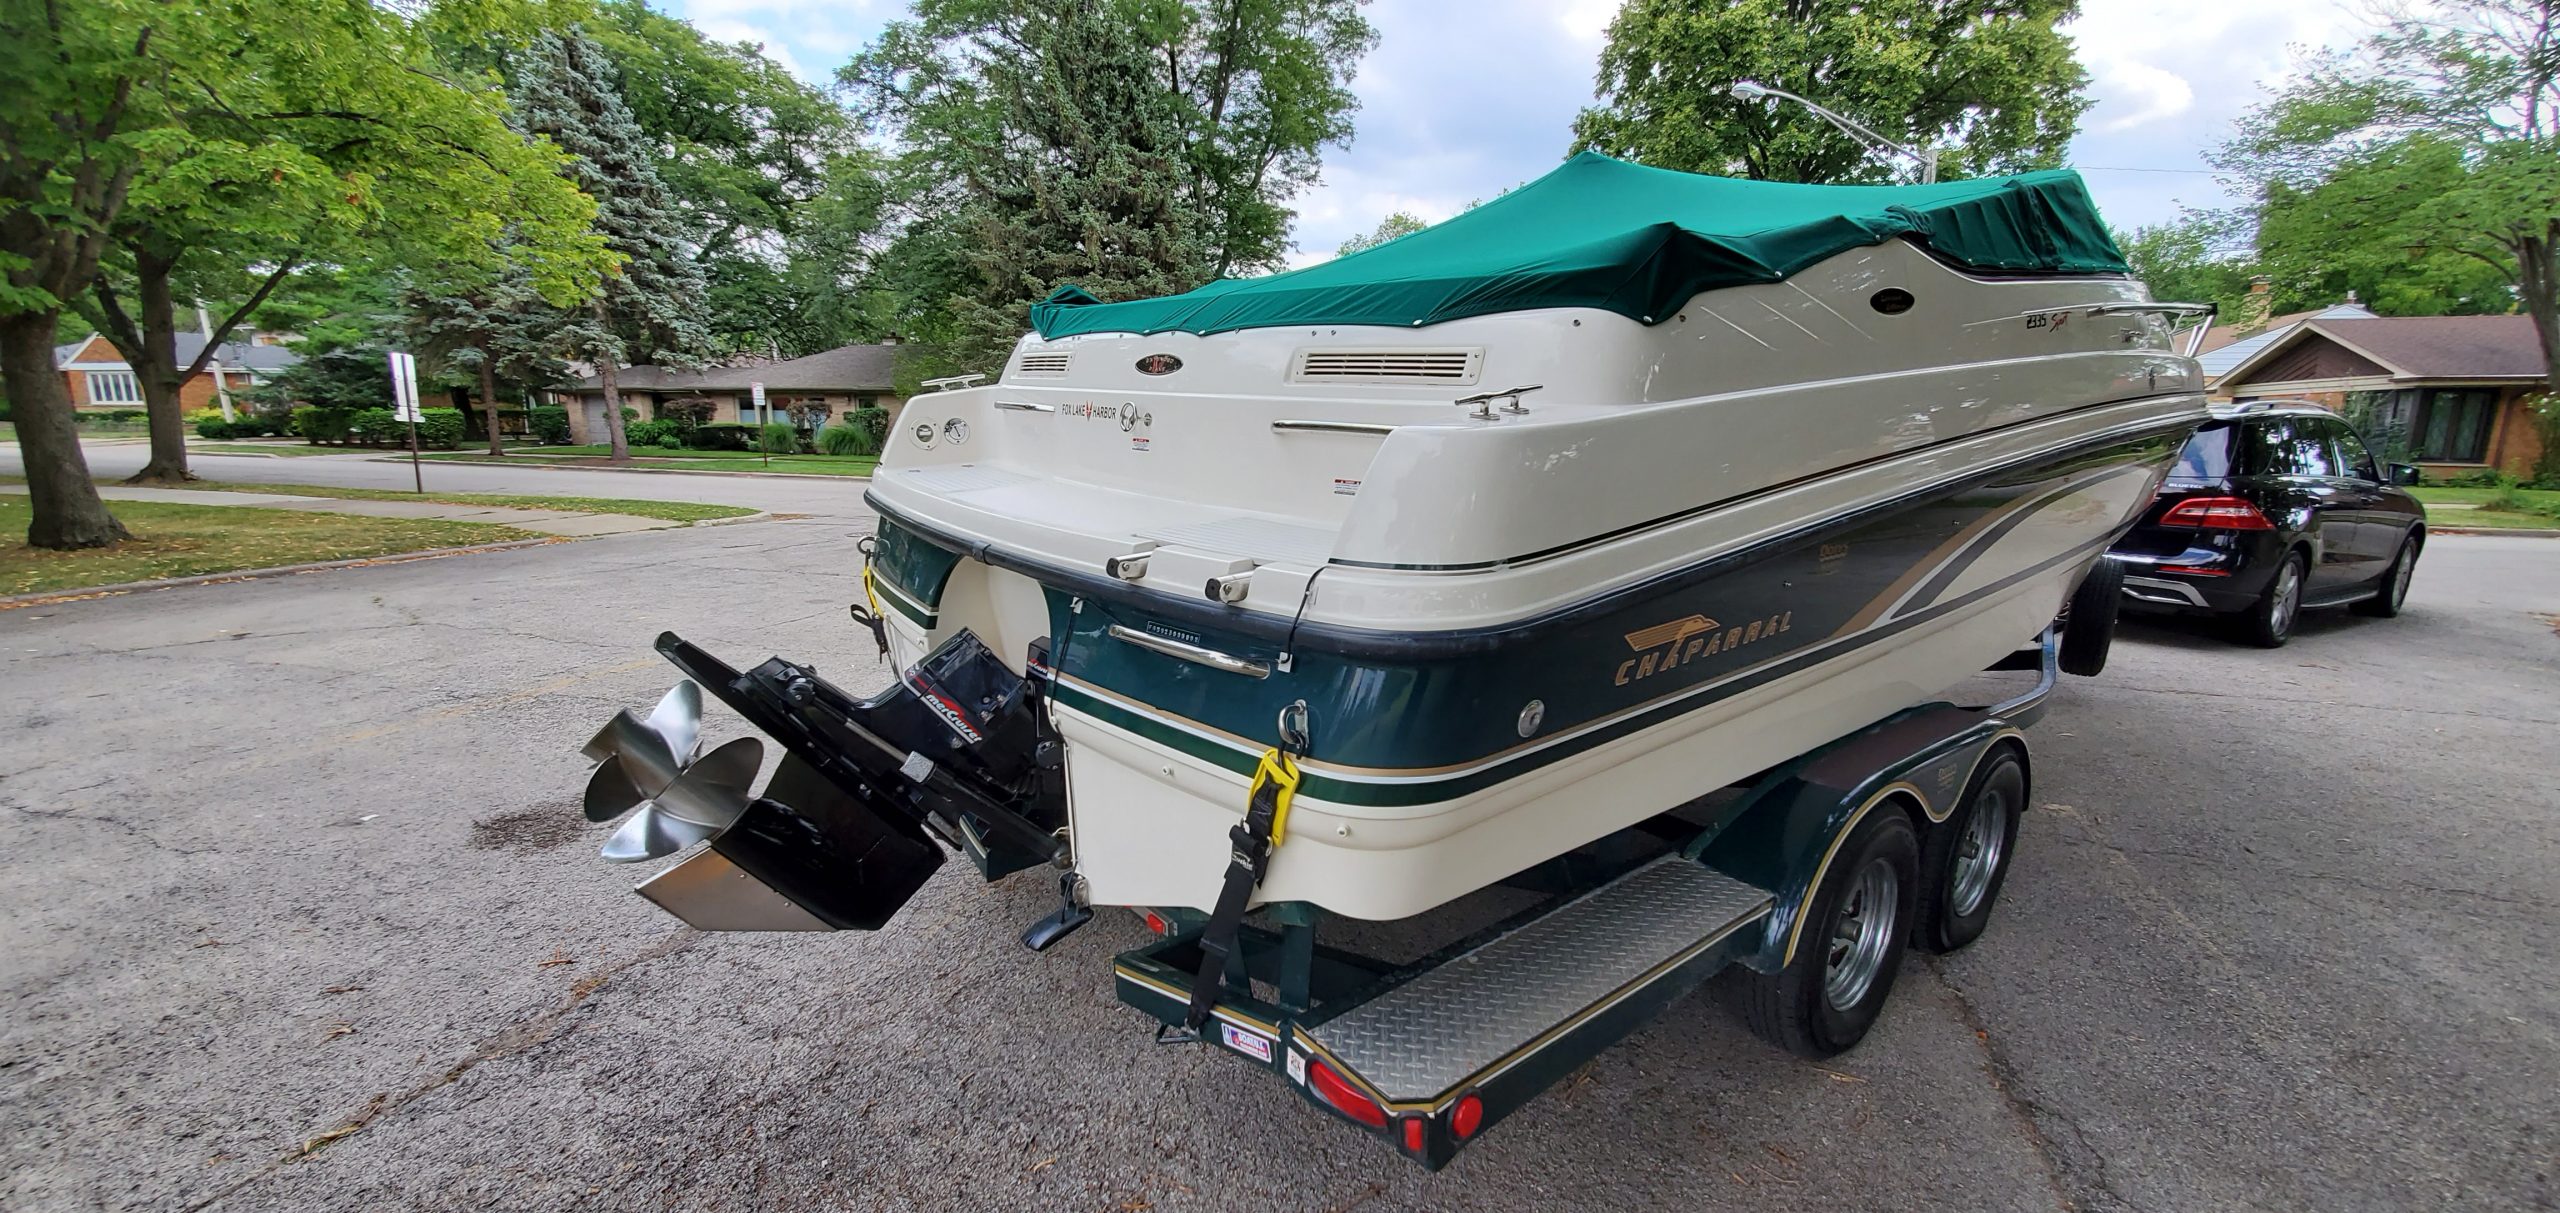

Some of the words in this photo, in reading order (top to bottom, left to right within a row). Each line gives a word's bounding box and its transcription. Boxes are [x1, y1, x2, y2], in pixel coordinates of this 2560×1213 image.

[2026, 313, 2047, 329] 2335
[1062, 404, 1072, 416] FOX
[1072, 404, 1086, 417] LAKE
[1092, 406, 1117, 420] HARBOR
[1615, 611, 1792, 686] CHAPARRAL
